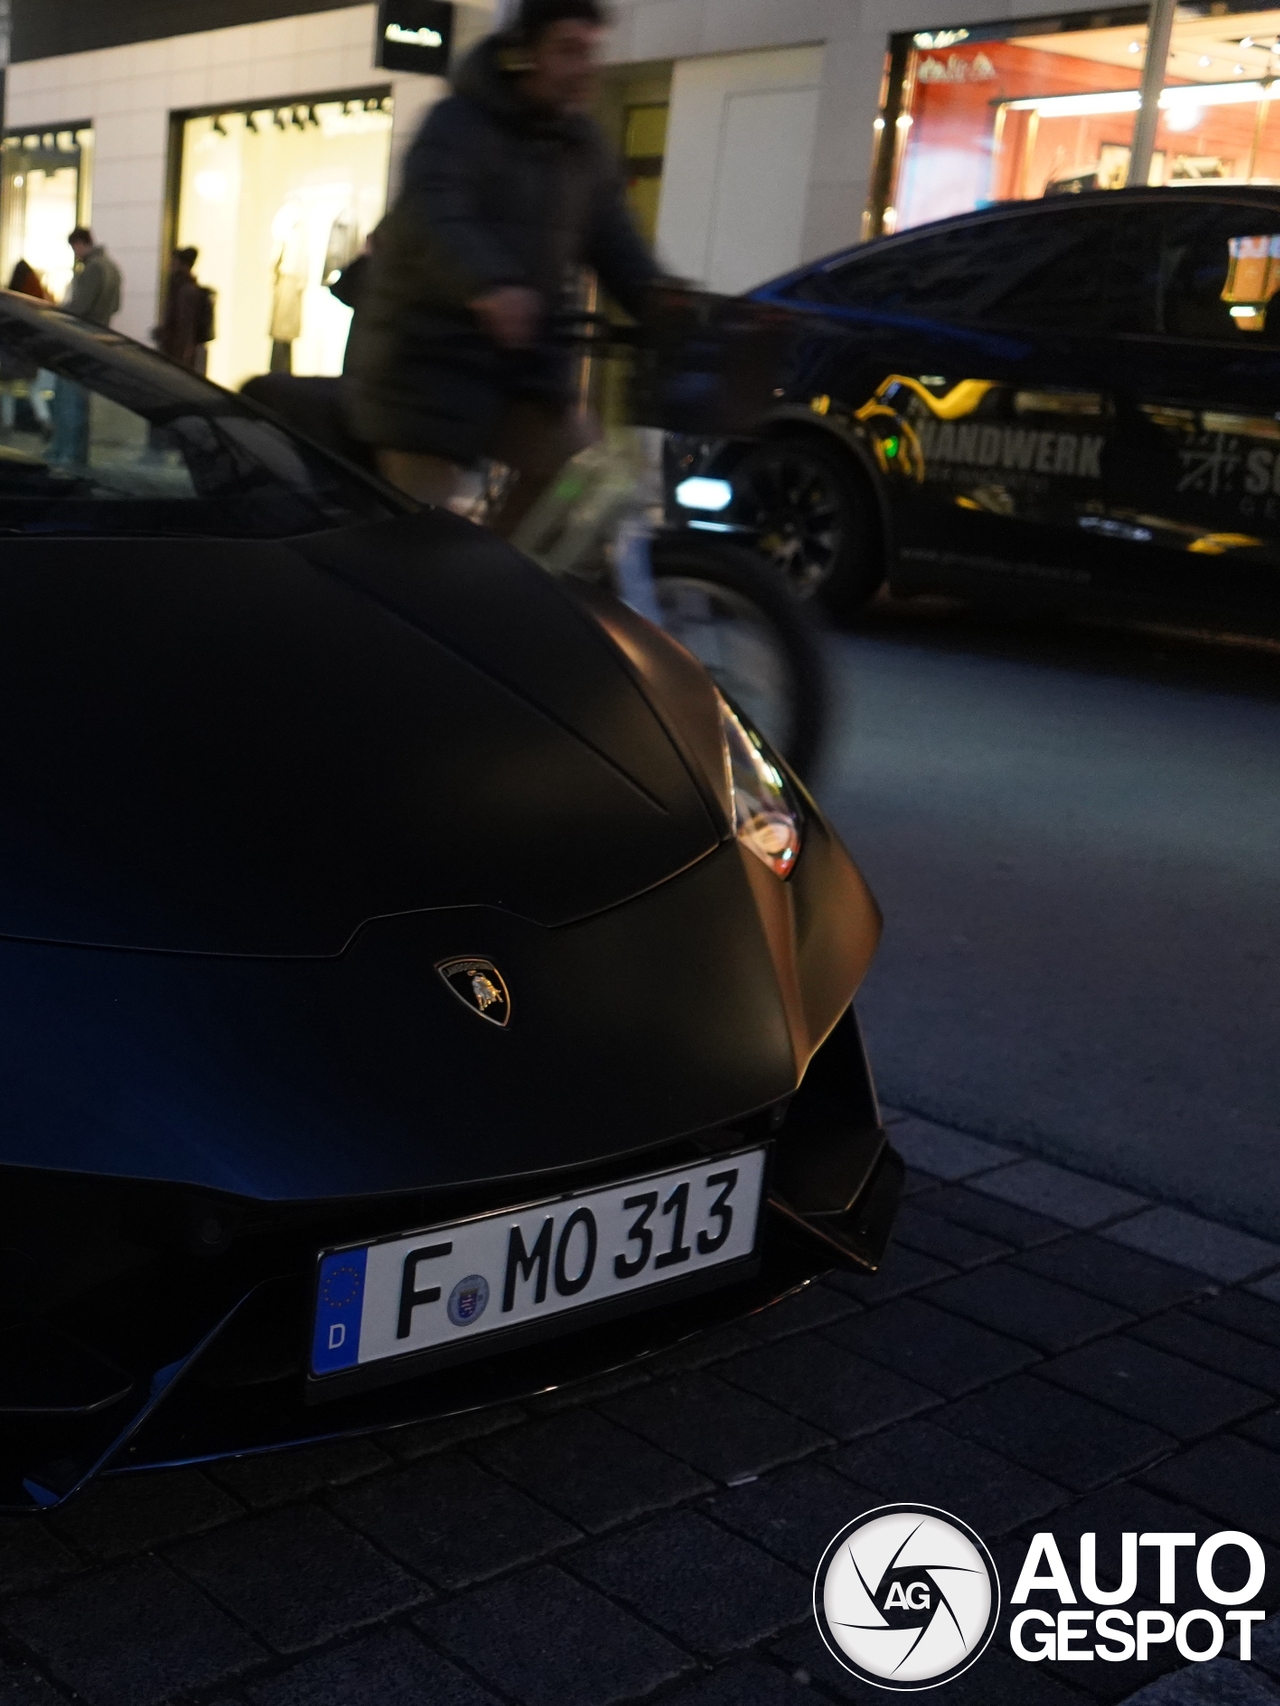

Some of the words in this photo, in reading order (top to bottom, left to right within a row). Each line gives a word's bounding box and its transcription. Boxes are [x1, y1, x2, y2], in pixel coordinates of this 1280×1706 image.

[396, 1241, 453, 1339] F
[501, 1206, 598, 1314] MO
[613, 1168, 739, 1280] 313
[328, 1323, 346, 1350] D
